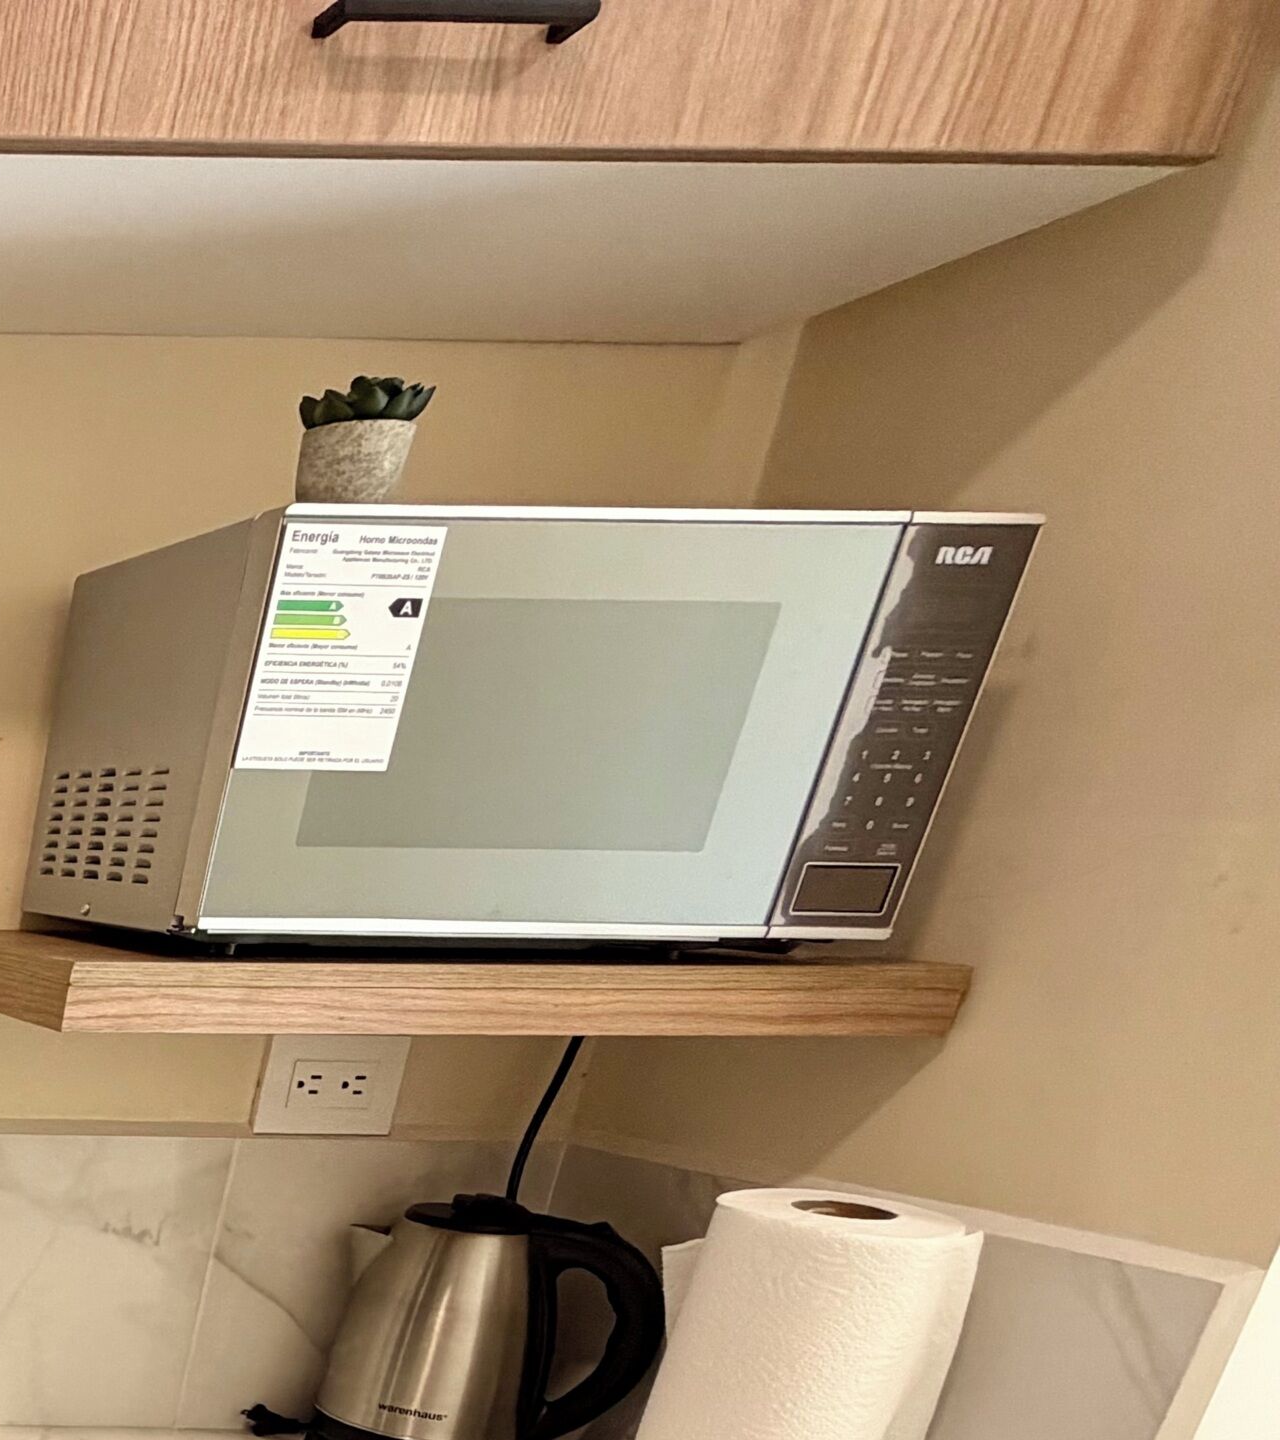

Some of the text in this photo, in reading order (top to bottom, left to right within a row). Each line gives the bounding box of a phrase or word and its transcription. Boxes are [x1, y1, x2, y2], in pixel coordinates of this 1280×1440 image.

[292, 530, 339, 546] Energía
[359, 535, 438, 545] Horno Microondas
[935, 546, 994, 565] RCA
[329, 601, 337, 610] A
[399, 600, 413, 616] A
[861, 750, 869, 760] 1
[891, 750, 901, 760] 2
[378, 1403, 443, 1421] warenhaus
